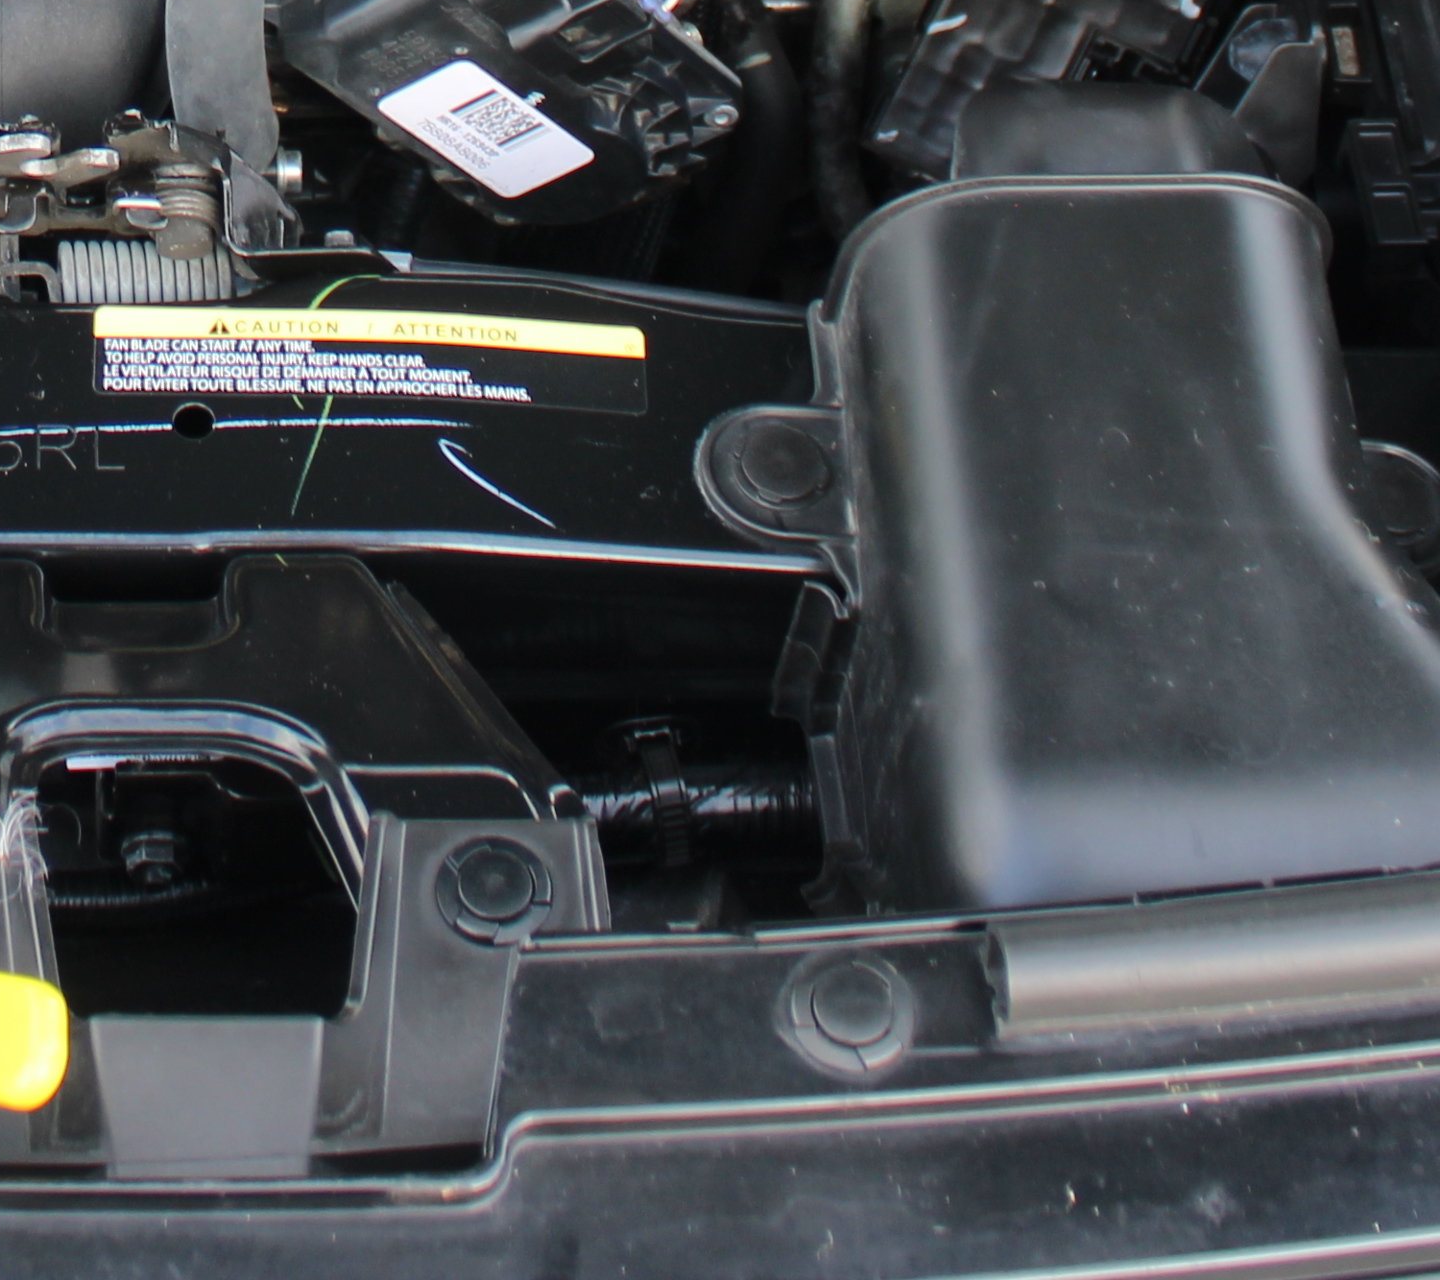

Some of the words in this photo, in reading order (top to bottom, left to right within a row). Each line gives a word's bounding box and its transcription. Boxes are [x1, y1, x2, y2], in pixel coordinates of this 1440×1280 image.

[235, 320, 339, 334] CAUTION
[393, 323, 518, 342] ATTENTION
[104, 339, 129, 352] FAN
[131, 339, 170, 352] BLADE
[171, 339, 198, 352] CAN
[201, 339, 237, 352] START
[239, 339, 255, 352] AT
[256, 339, 283, 353] ANY
[283, 340, 315, 353] TIME.
[105, 352, 121, 364] TO
[124, 352, 155, 364] HELP
[157, 353, 195, 364] AVOID
[197, 353, 260, 365] PERSONAL
[262, 354, 306, 367] INJURY,
[307, 354, 337, 366] KEEP
[339, 354, 382, 367] HANDS
[384, 355, 427, 369] CLEAR.
[103, 364, 120, 377] LE
[121, 365, 208, 378] VENTILATEUR
[211, 366, 260, 379] RISQUE
[262, 366, 280, 379] DE
[282, 365, 357, 380] DÉMARRER
[371, 368, 407, 381] TOUT
[409, 370, 473, 385] MOMENT.
[103, 379, 142, 391] POUR
[144, 377, 189, 391] ÉVITER
[191, 379, 234, 391] TOUTE
[236, 379, 305, 393] BLESSURE,
[307, 380, 328, 392] NE
[328, 380, 354, 393] PAS
[356, 381, 375, 393] EN
[376, 382, 457, 396] APPROCHER
[459, 385, 482, 398] LES
[483, 386, 532, 402] MAINS.
